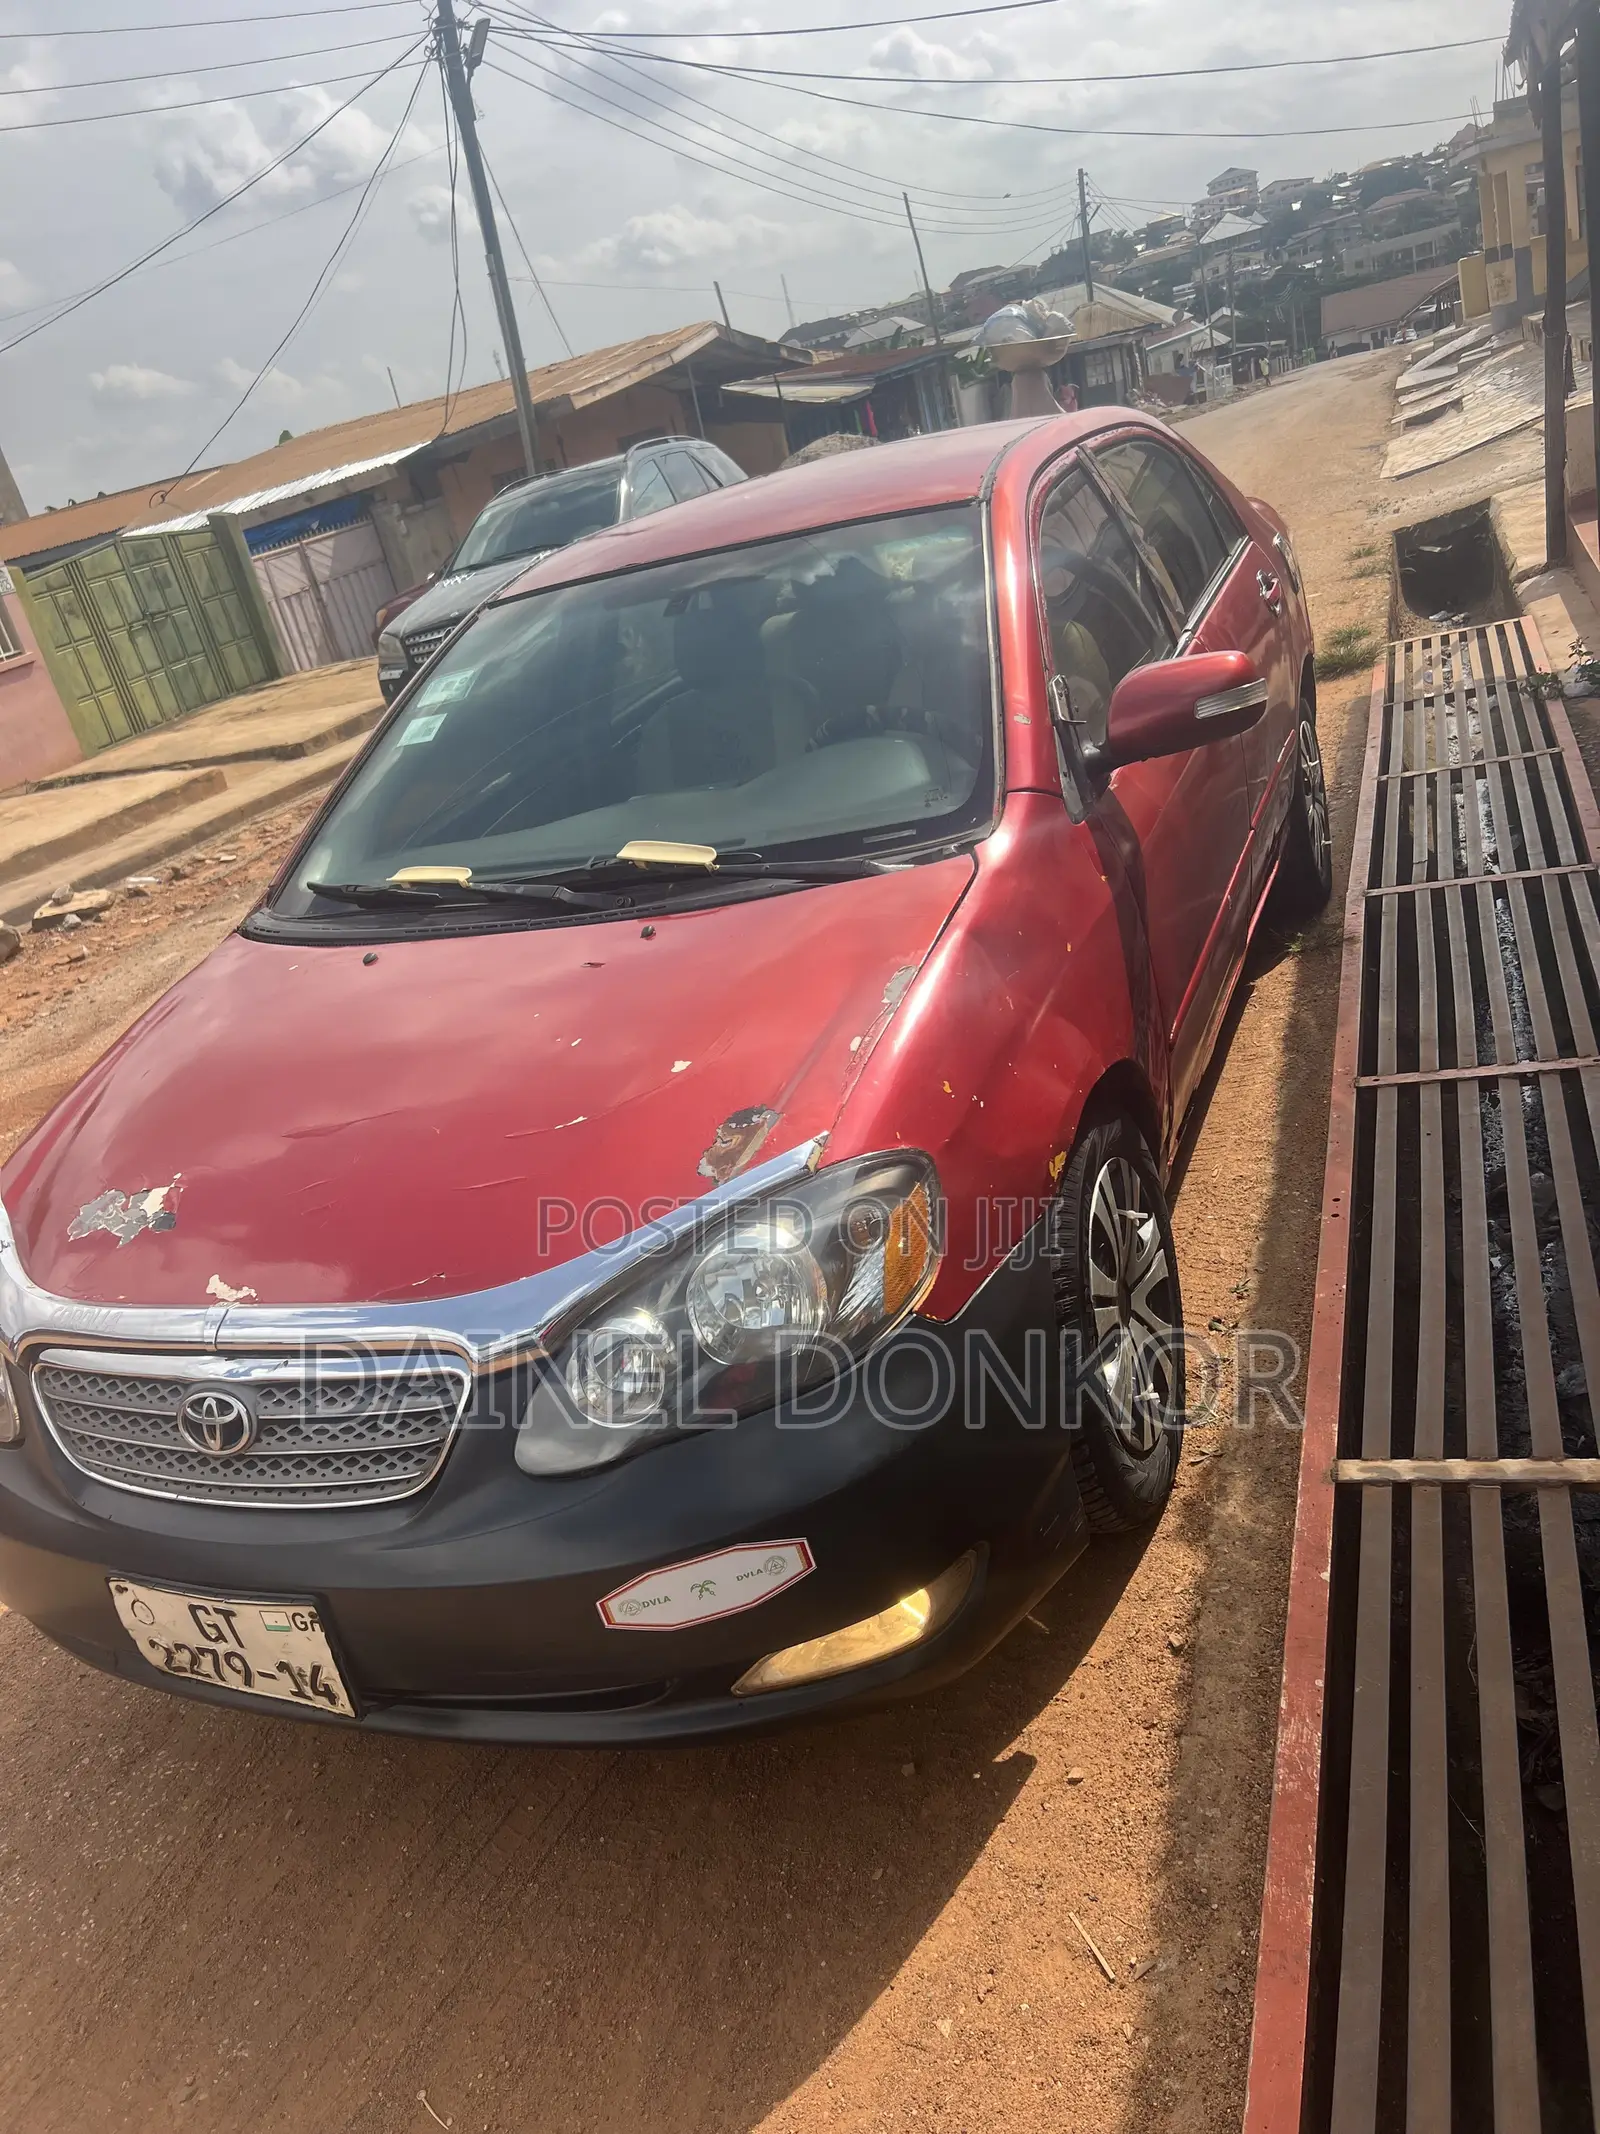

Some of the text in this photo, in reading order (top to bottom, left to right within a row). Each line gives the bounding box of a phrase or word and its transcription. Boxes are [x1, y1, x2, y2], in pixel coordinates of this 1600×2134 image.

[735, 1568, 764, 1582] DVLA
[641, 1595, 672, 1609] DVLA
[188, 1602, 246, 1649] GT
[148, 1638, 343, 1706] 2279-14
